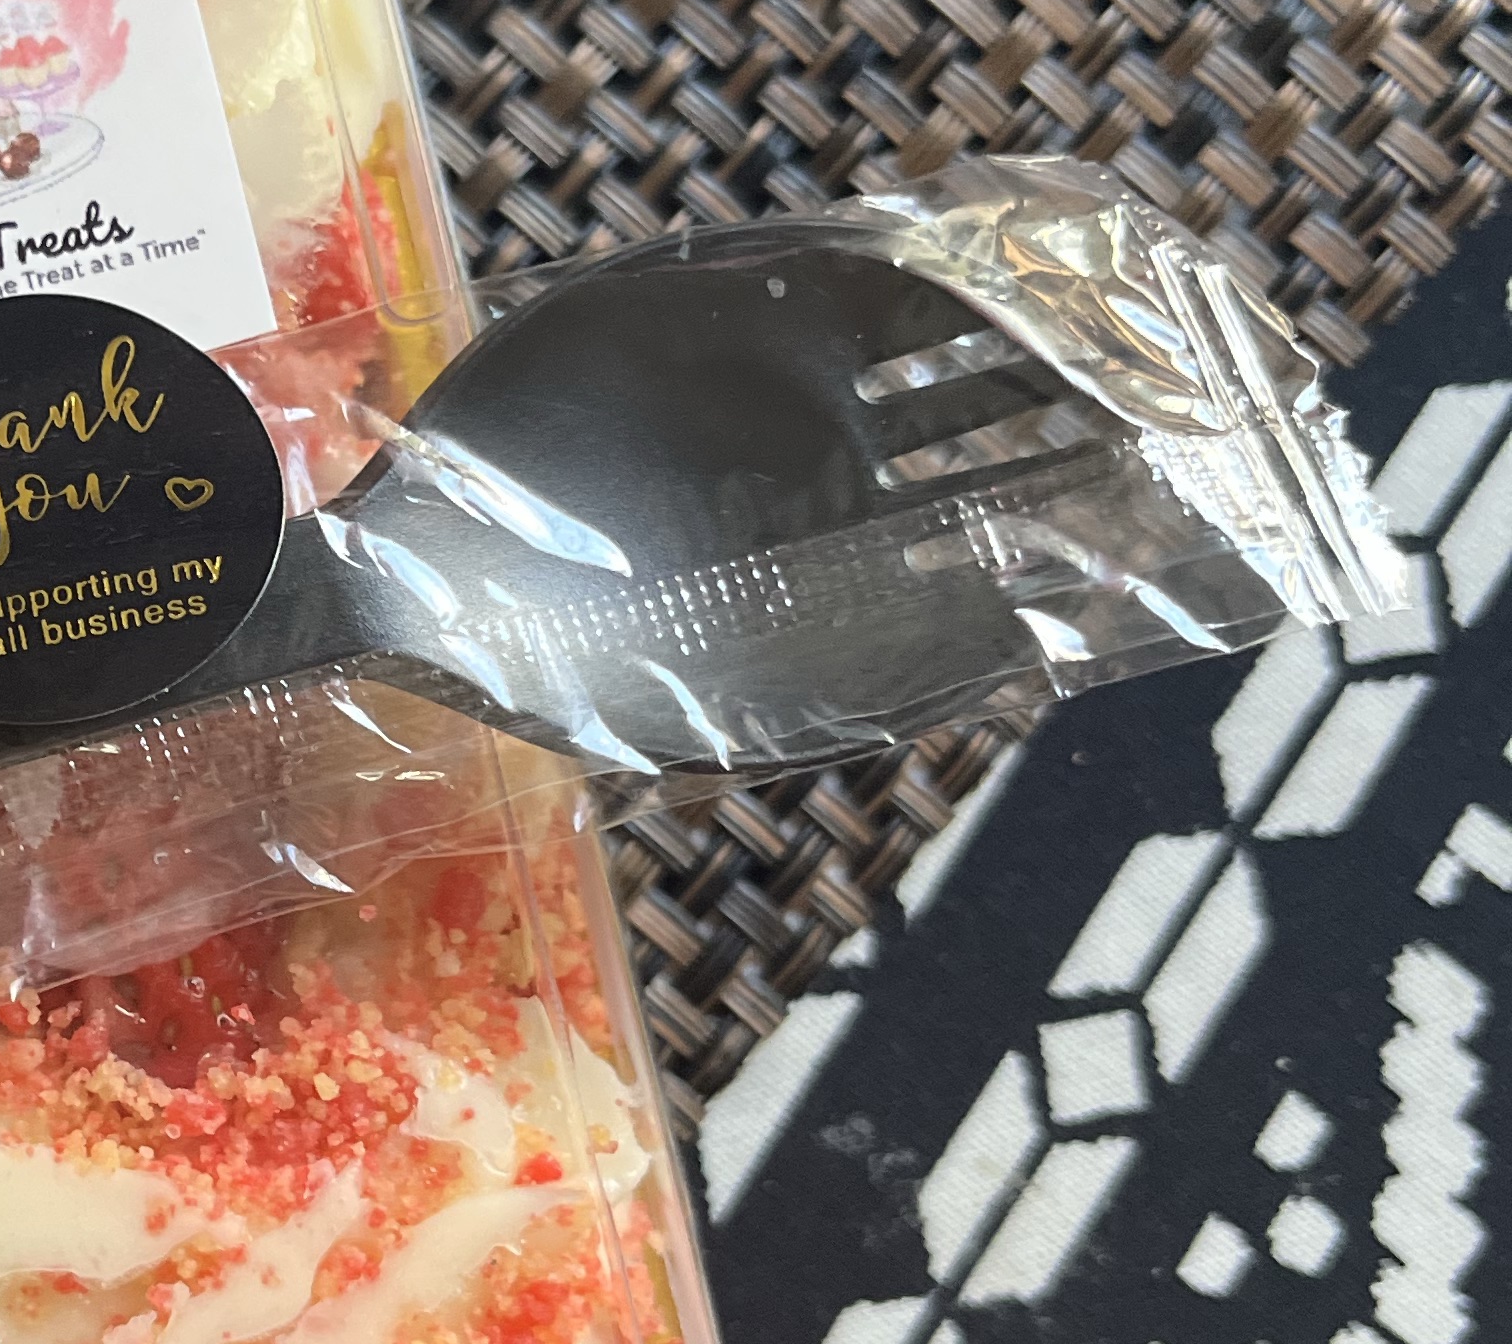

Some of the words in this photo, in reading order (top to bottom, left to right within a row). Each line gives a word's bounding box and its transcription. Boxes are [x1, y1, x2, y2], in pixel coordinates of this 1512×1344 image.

[20, 260, 85, 292] Treat
[90, 255, 114, 275] at
[118, 251, 134, 268] a
[173, 554, 223, 583] my
[42, 592, 208, 646] business
